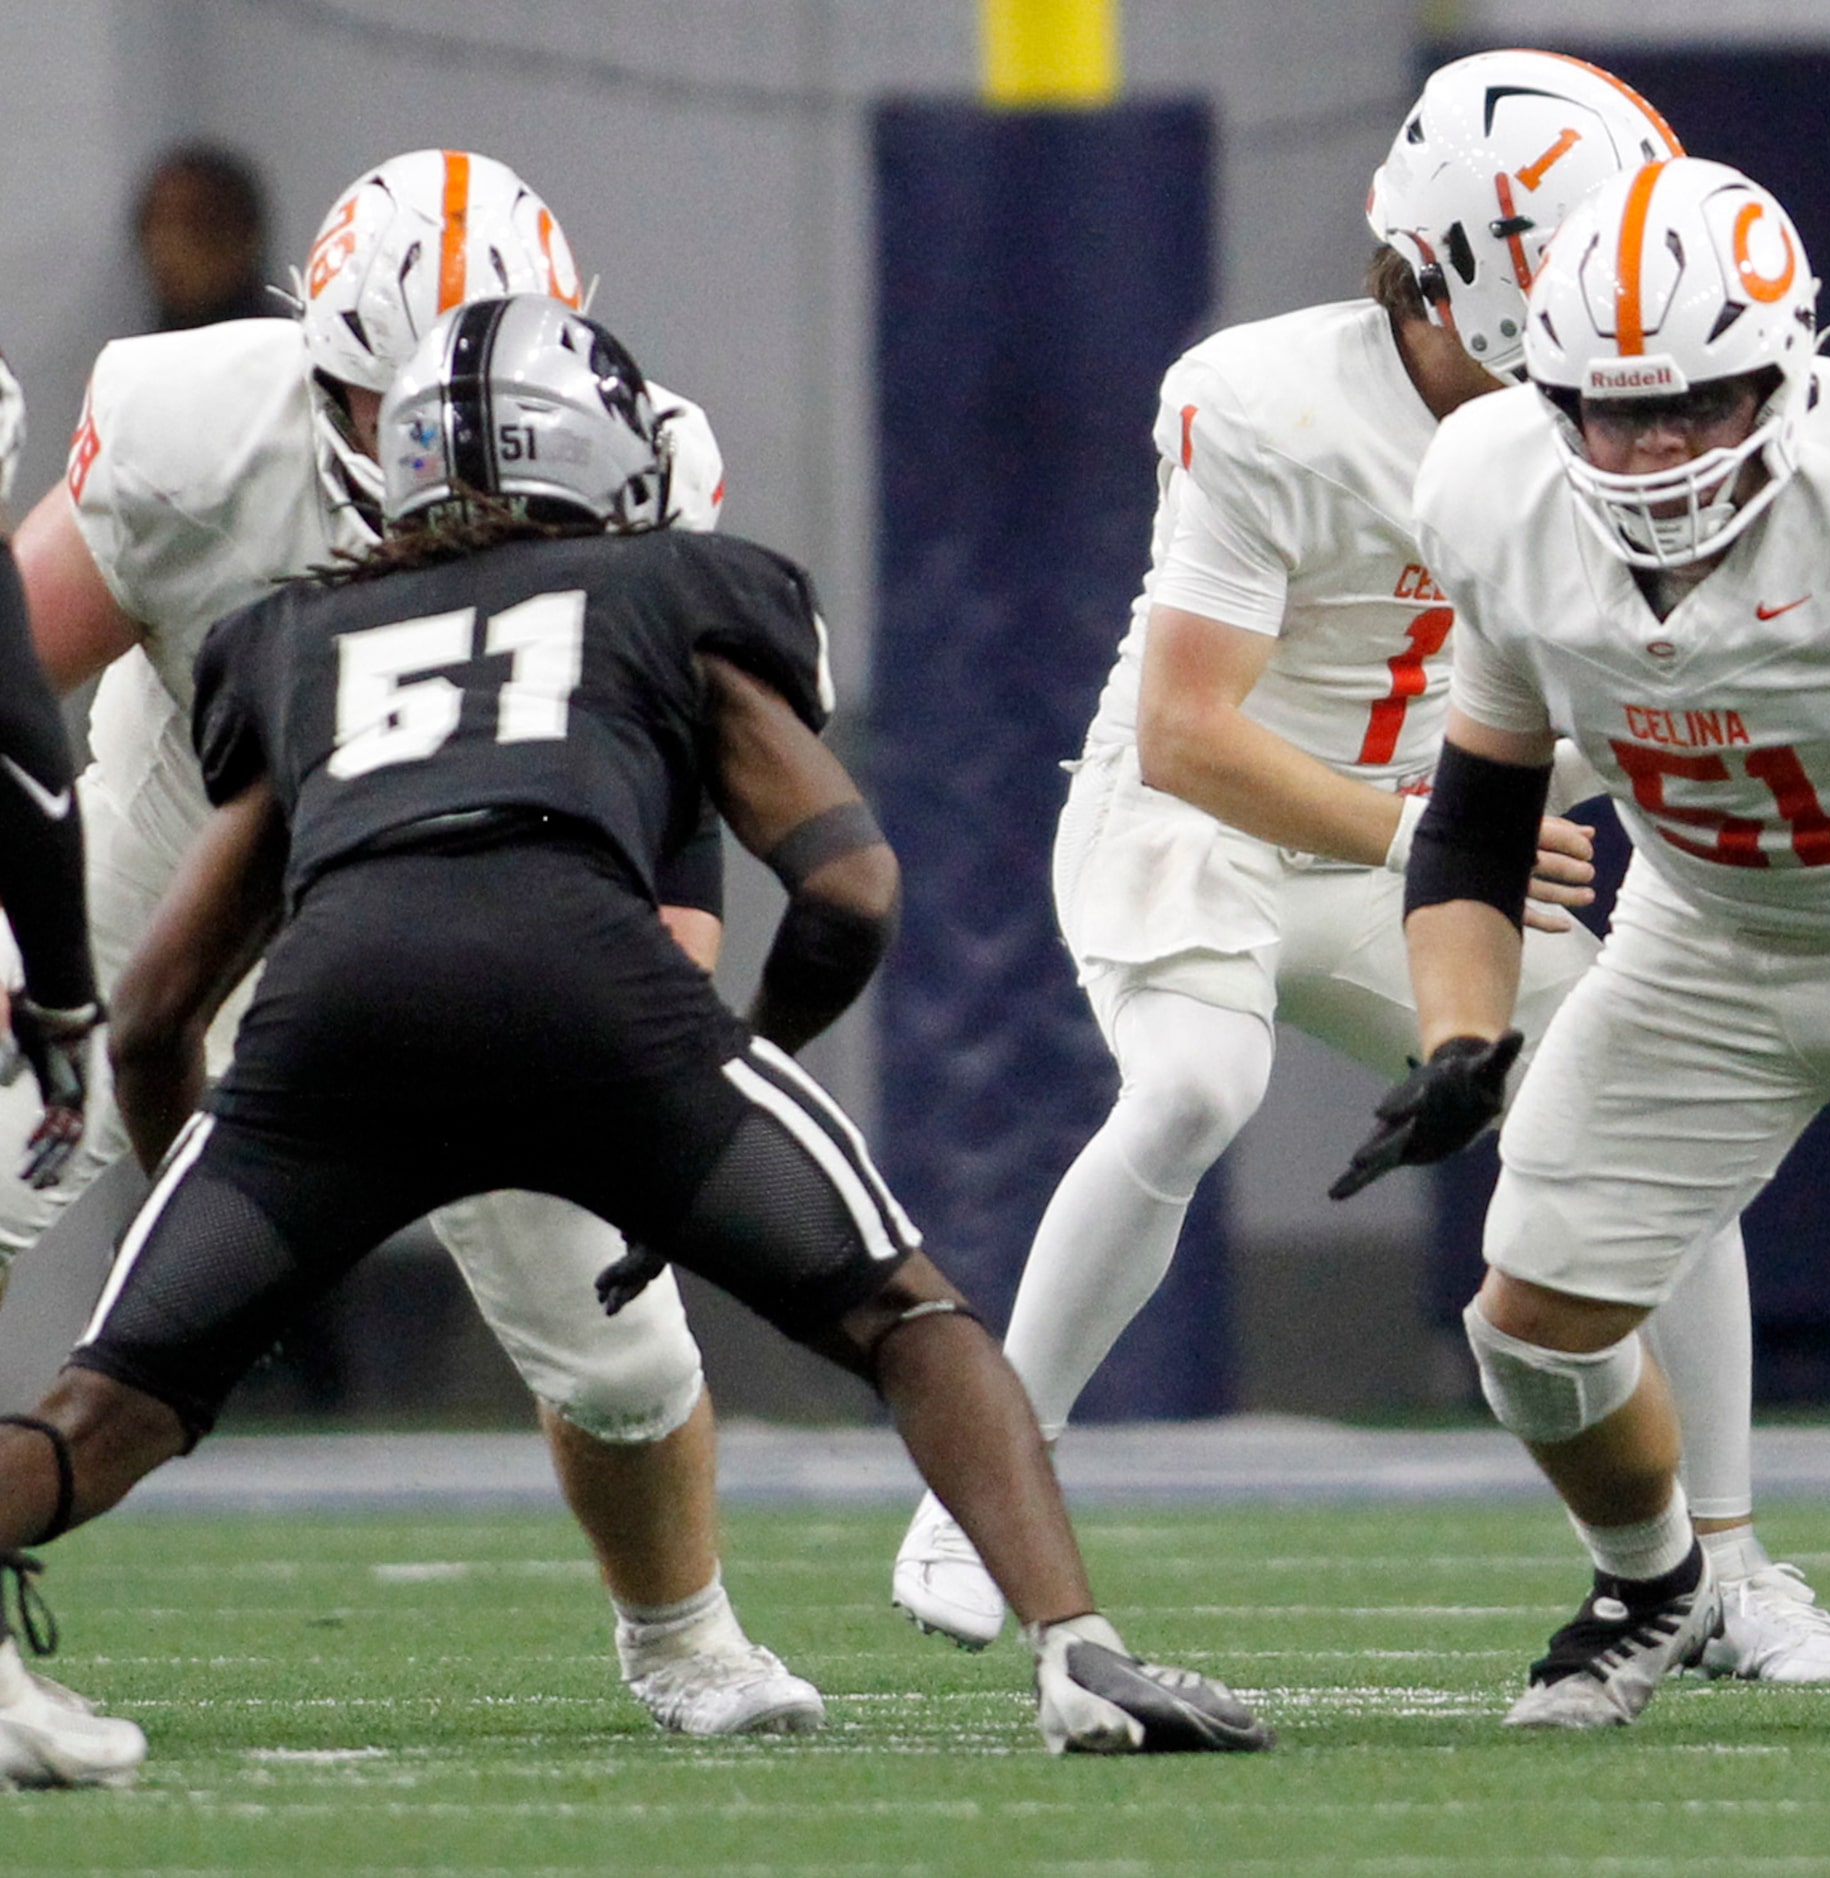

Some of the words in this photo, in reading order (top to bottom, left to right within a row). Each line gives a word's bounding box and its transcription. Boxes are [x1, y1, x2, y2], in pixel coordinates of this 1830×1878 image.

[1514, 128, 1582, 192] 1
[1733, 202, 1796, 303] C
[1591, 368, 1672, 388] Riddell
[500, 424, 536, 461] 51
[327, 589, 586, 781] 51
[1355, 607, 1454, 765] 1
[1624, 704, 1749, 747] CELINA
